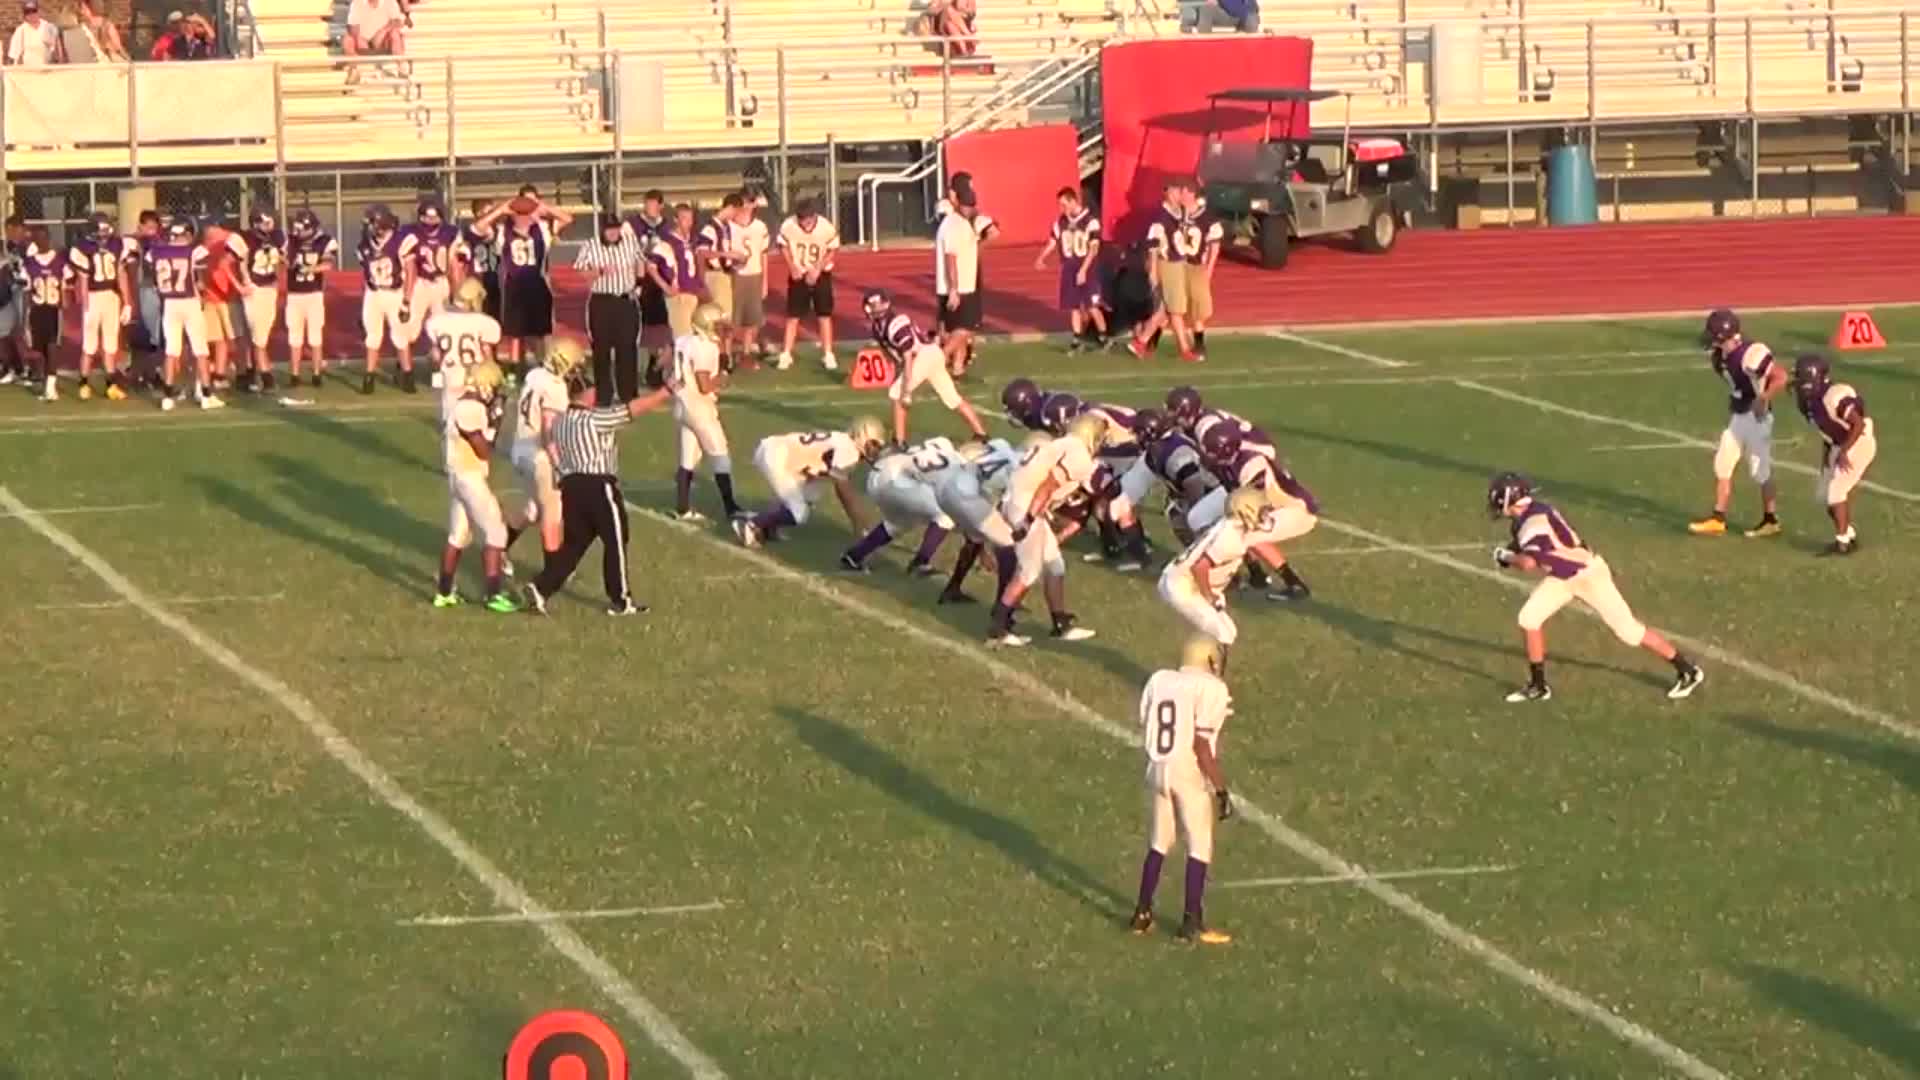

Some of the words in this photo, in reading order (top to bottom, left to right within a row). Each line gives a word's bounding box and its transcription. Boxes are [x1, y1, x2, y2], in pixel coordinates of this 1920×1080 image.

[155, 258, 189, 293] 27
[1848, 317, 1873, 344] 20
[859, 354, 886, 381] 30
[1157, 700, 1176, 754] 8
